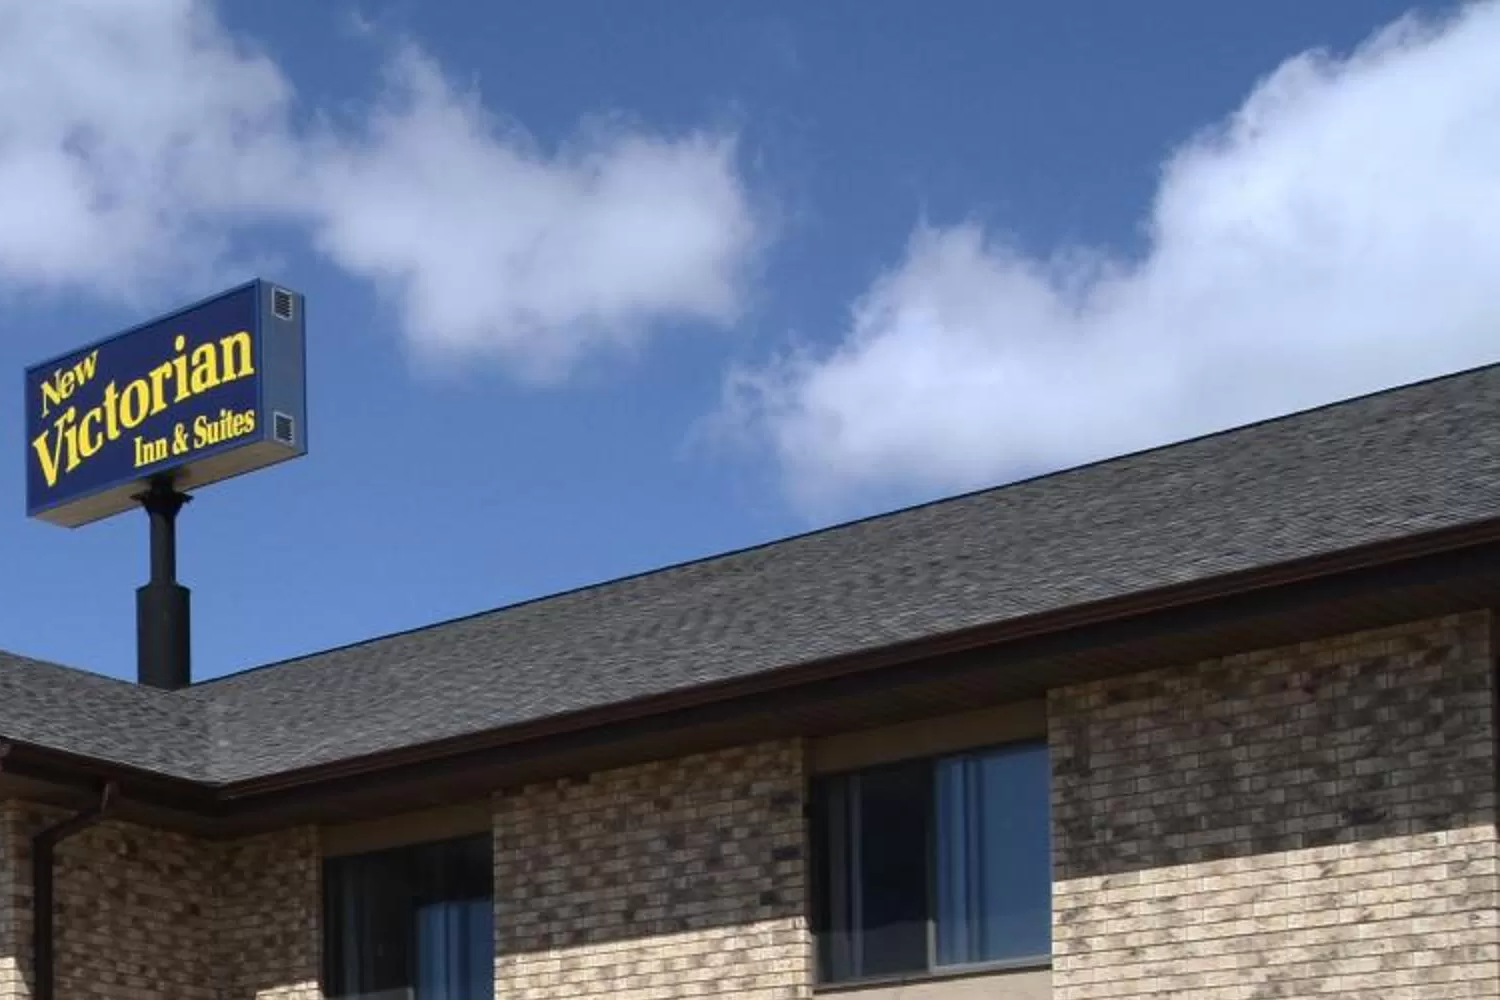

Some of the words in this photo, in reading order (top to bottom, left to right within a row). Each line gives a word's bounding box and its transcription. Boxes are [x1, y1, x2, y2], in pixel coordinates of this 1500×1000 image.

[31, 330, 255, 488] Victorian
[40, 349, 99, 419] New
[132, 435, 168, 467] Inn
[172, 422, 189, 455] &
[193, 408, 256, 449] Suites
